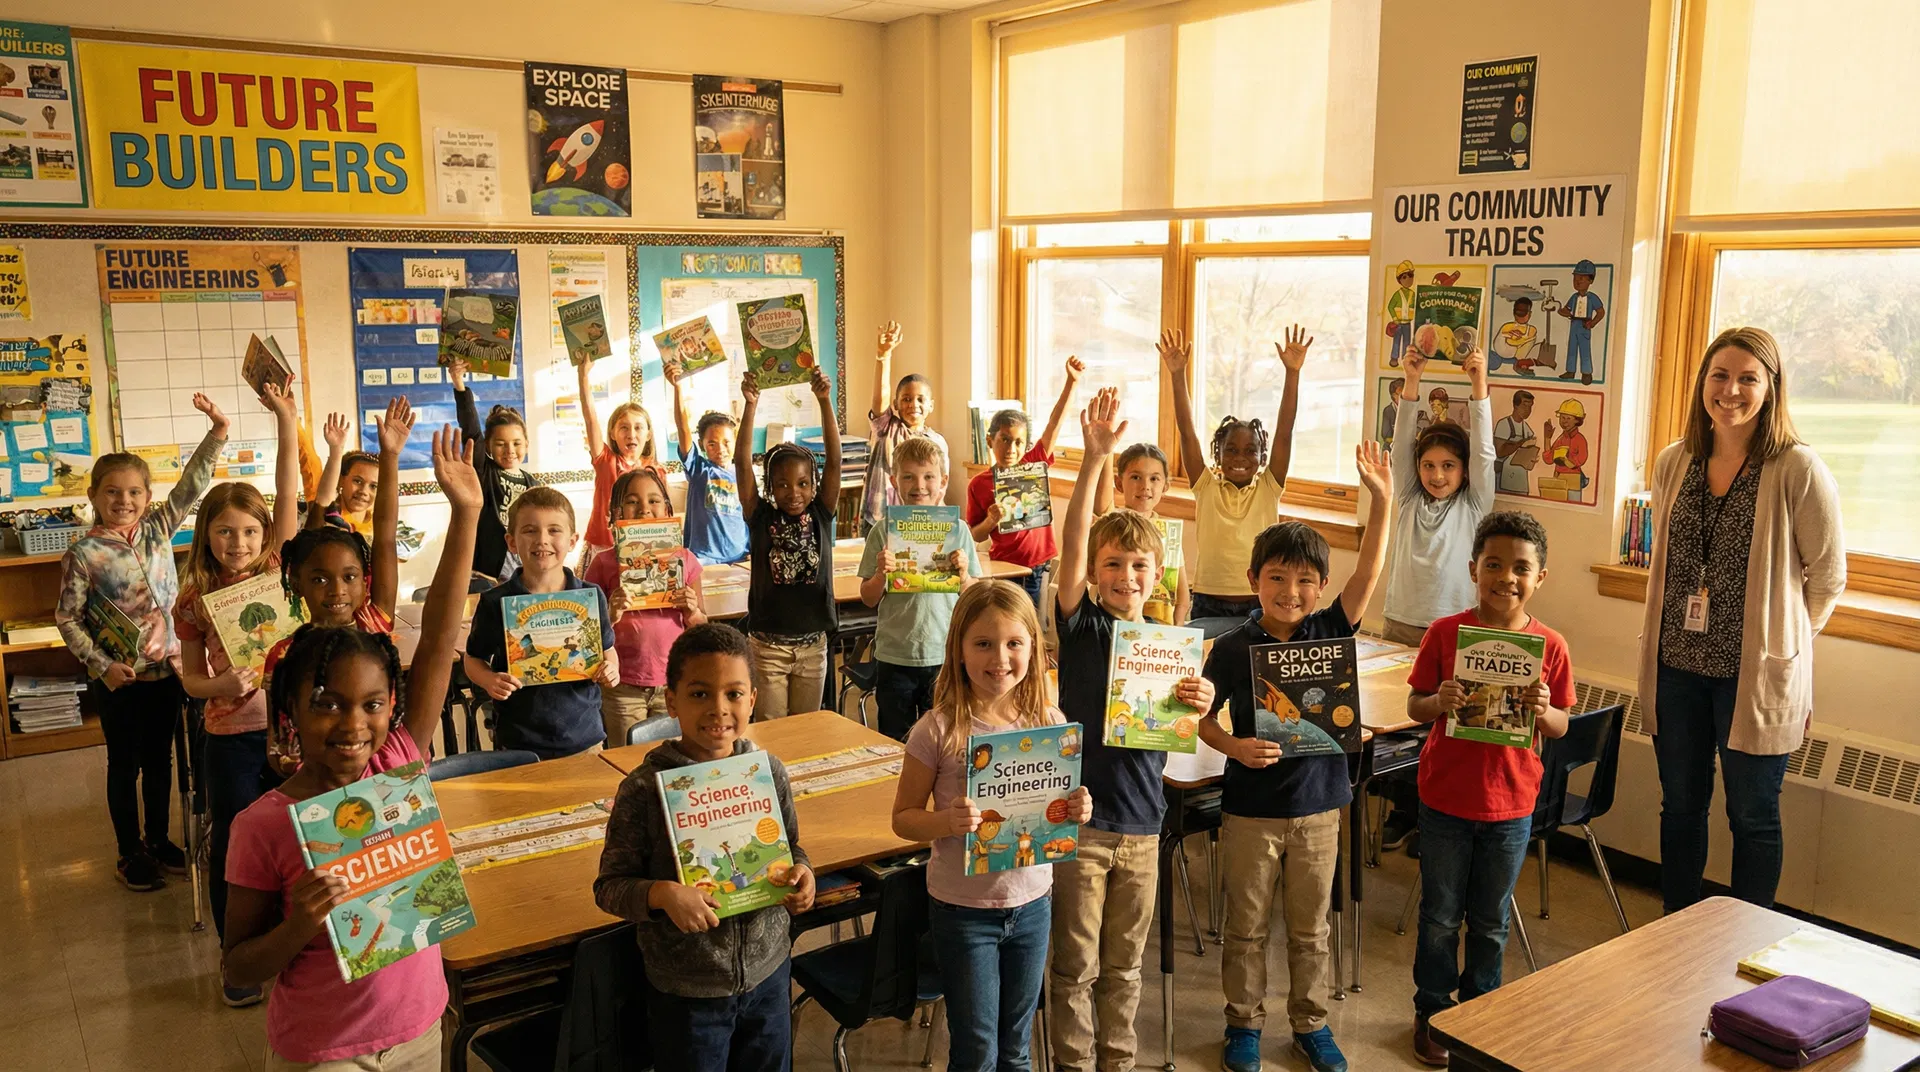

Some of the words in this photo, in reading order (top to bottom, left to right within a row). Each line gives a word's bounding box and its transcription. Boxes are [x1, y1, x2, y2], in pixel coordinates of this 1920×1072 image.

[532, 69, 621, 91] EXPLORE
[1466, 68, 1483, 79] OUR
[138, 67, 378, 133] FUTURE
[544, 88, 611, 109] SPACE
[110, 131, 408, 195] BUILDERS
[1394, 193, 1440, 223] OUR
[1448, 184, 1612, 222] COMMUNITY
[1445, 225, 1544, 257] TRADES
[105, 249, 190, 268] FUTURE
[107, 269, 260, 290] ENGINEERINS
[1132, 643, 1184, 662] Science,
[1268, 645, 1343, 664] EXPLORE
[1117, 656, 1195, 678] Engineering
[1280, 661, 1333, 678] SPACE
[1464, 655, 1533, 677] TRADES
[993, 760, 1058, 779] Science,
[977, 773, 1072, 800] Engineering
[675, 797, 772, 829] Engineering
[328, 828, 440, 889] SCIENCE
